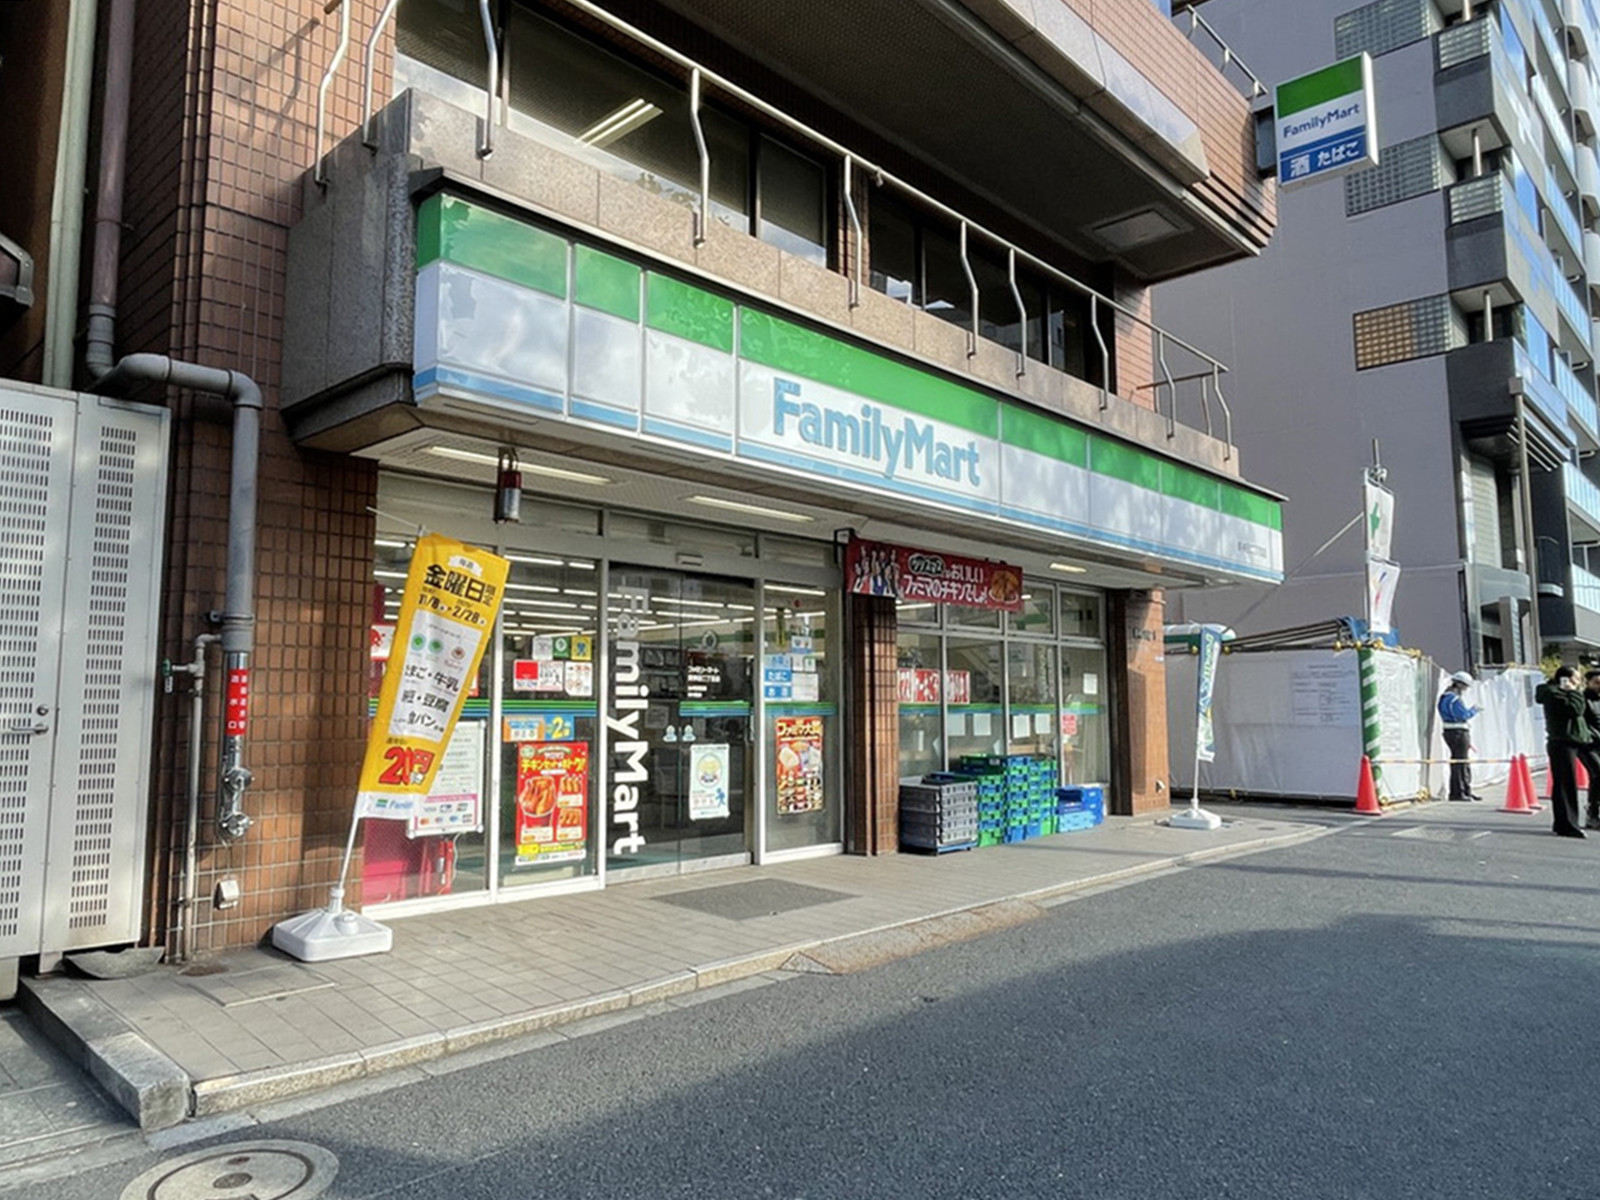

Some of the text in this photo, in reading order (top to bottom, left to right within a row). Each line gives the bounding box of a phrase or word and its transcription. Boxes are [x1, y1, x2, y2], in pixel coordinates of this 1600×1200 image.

[1283, 103, 1360, 139] FamilyMart
[1290, 141, 1360, 178] 酒 たばこ
[773, 377, 981, 487] FamilyMart
[424, 563, 487, 603] 金曜日
[606, 586, 650, 855] FamilyMart
